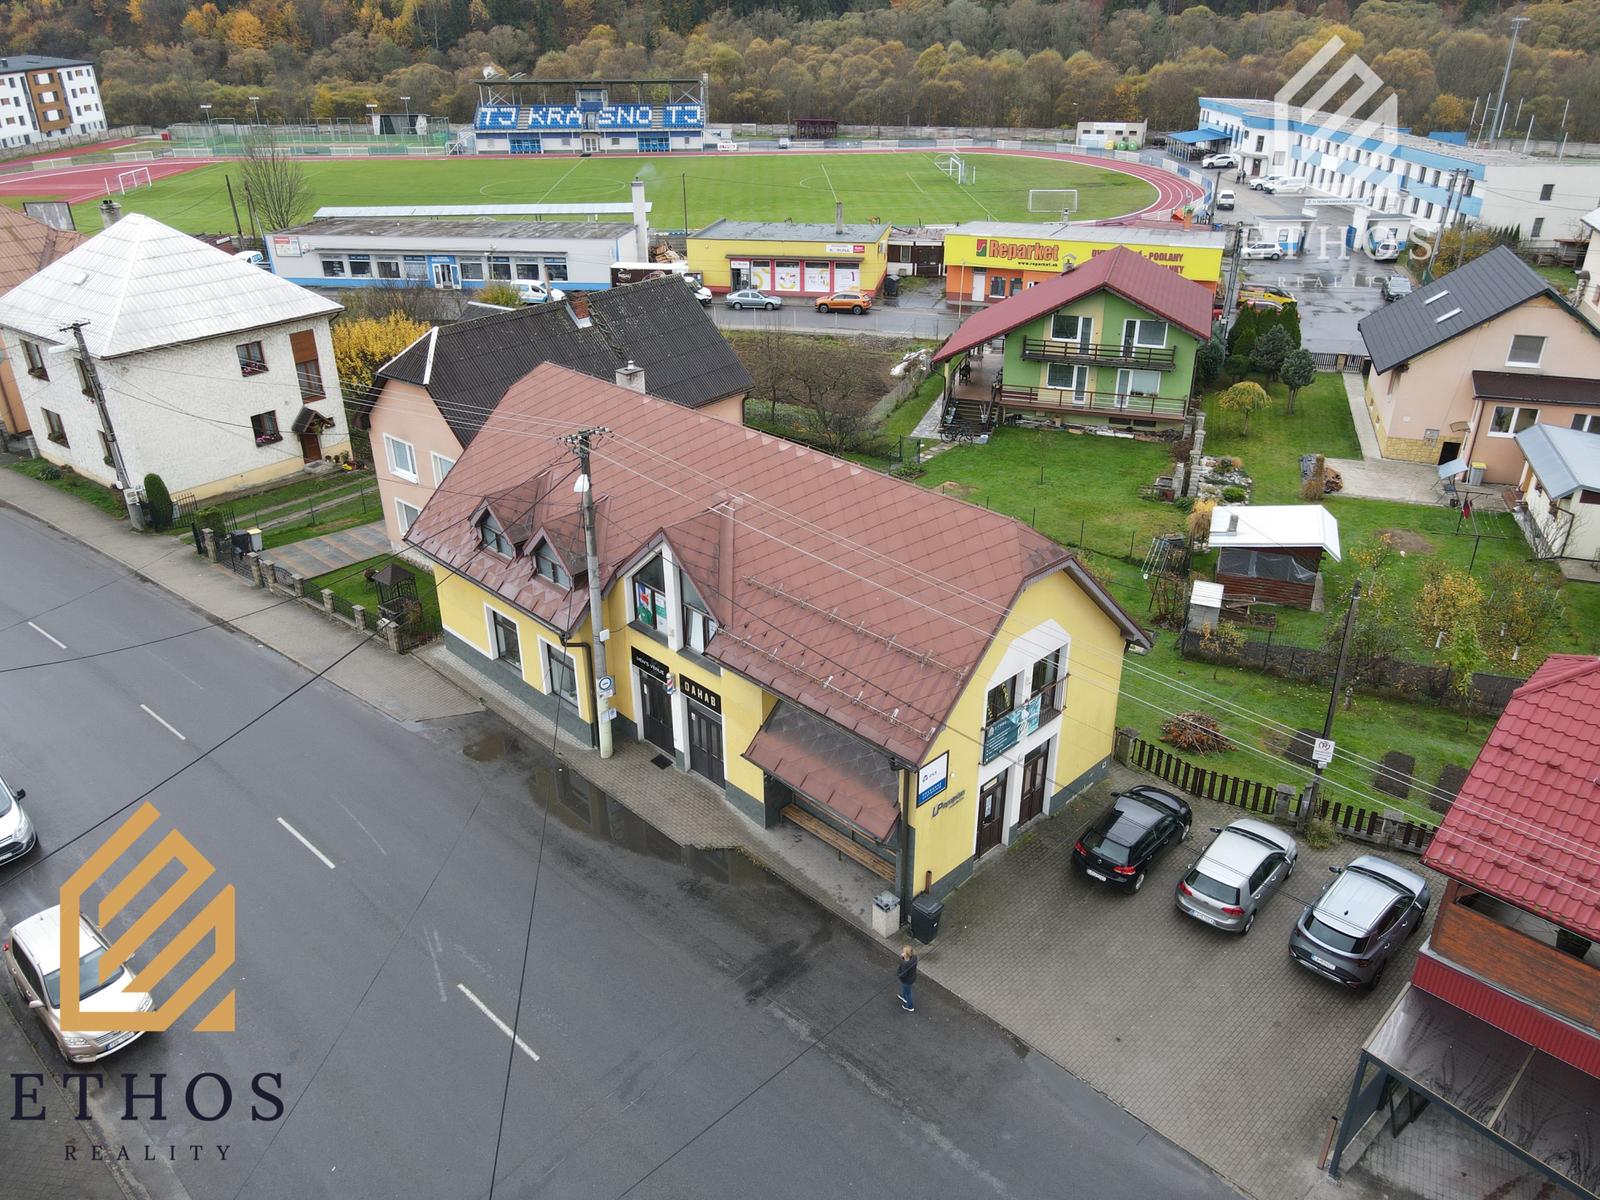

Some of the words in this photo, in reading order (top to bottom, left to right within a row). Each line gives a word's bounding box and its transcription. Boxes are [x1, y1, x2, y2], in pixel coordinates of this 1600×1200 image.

[479, 107, 516, 126] TJ
[598, 106, 652, 125] SNO
[666, 106, 701, 124] TJ
[988, 239, 1060, 261] Reparket
[684, 681, 717, 707] DAHAB
